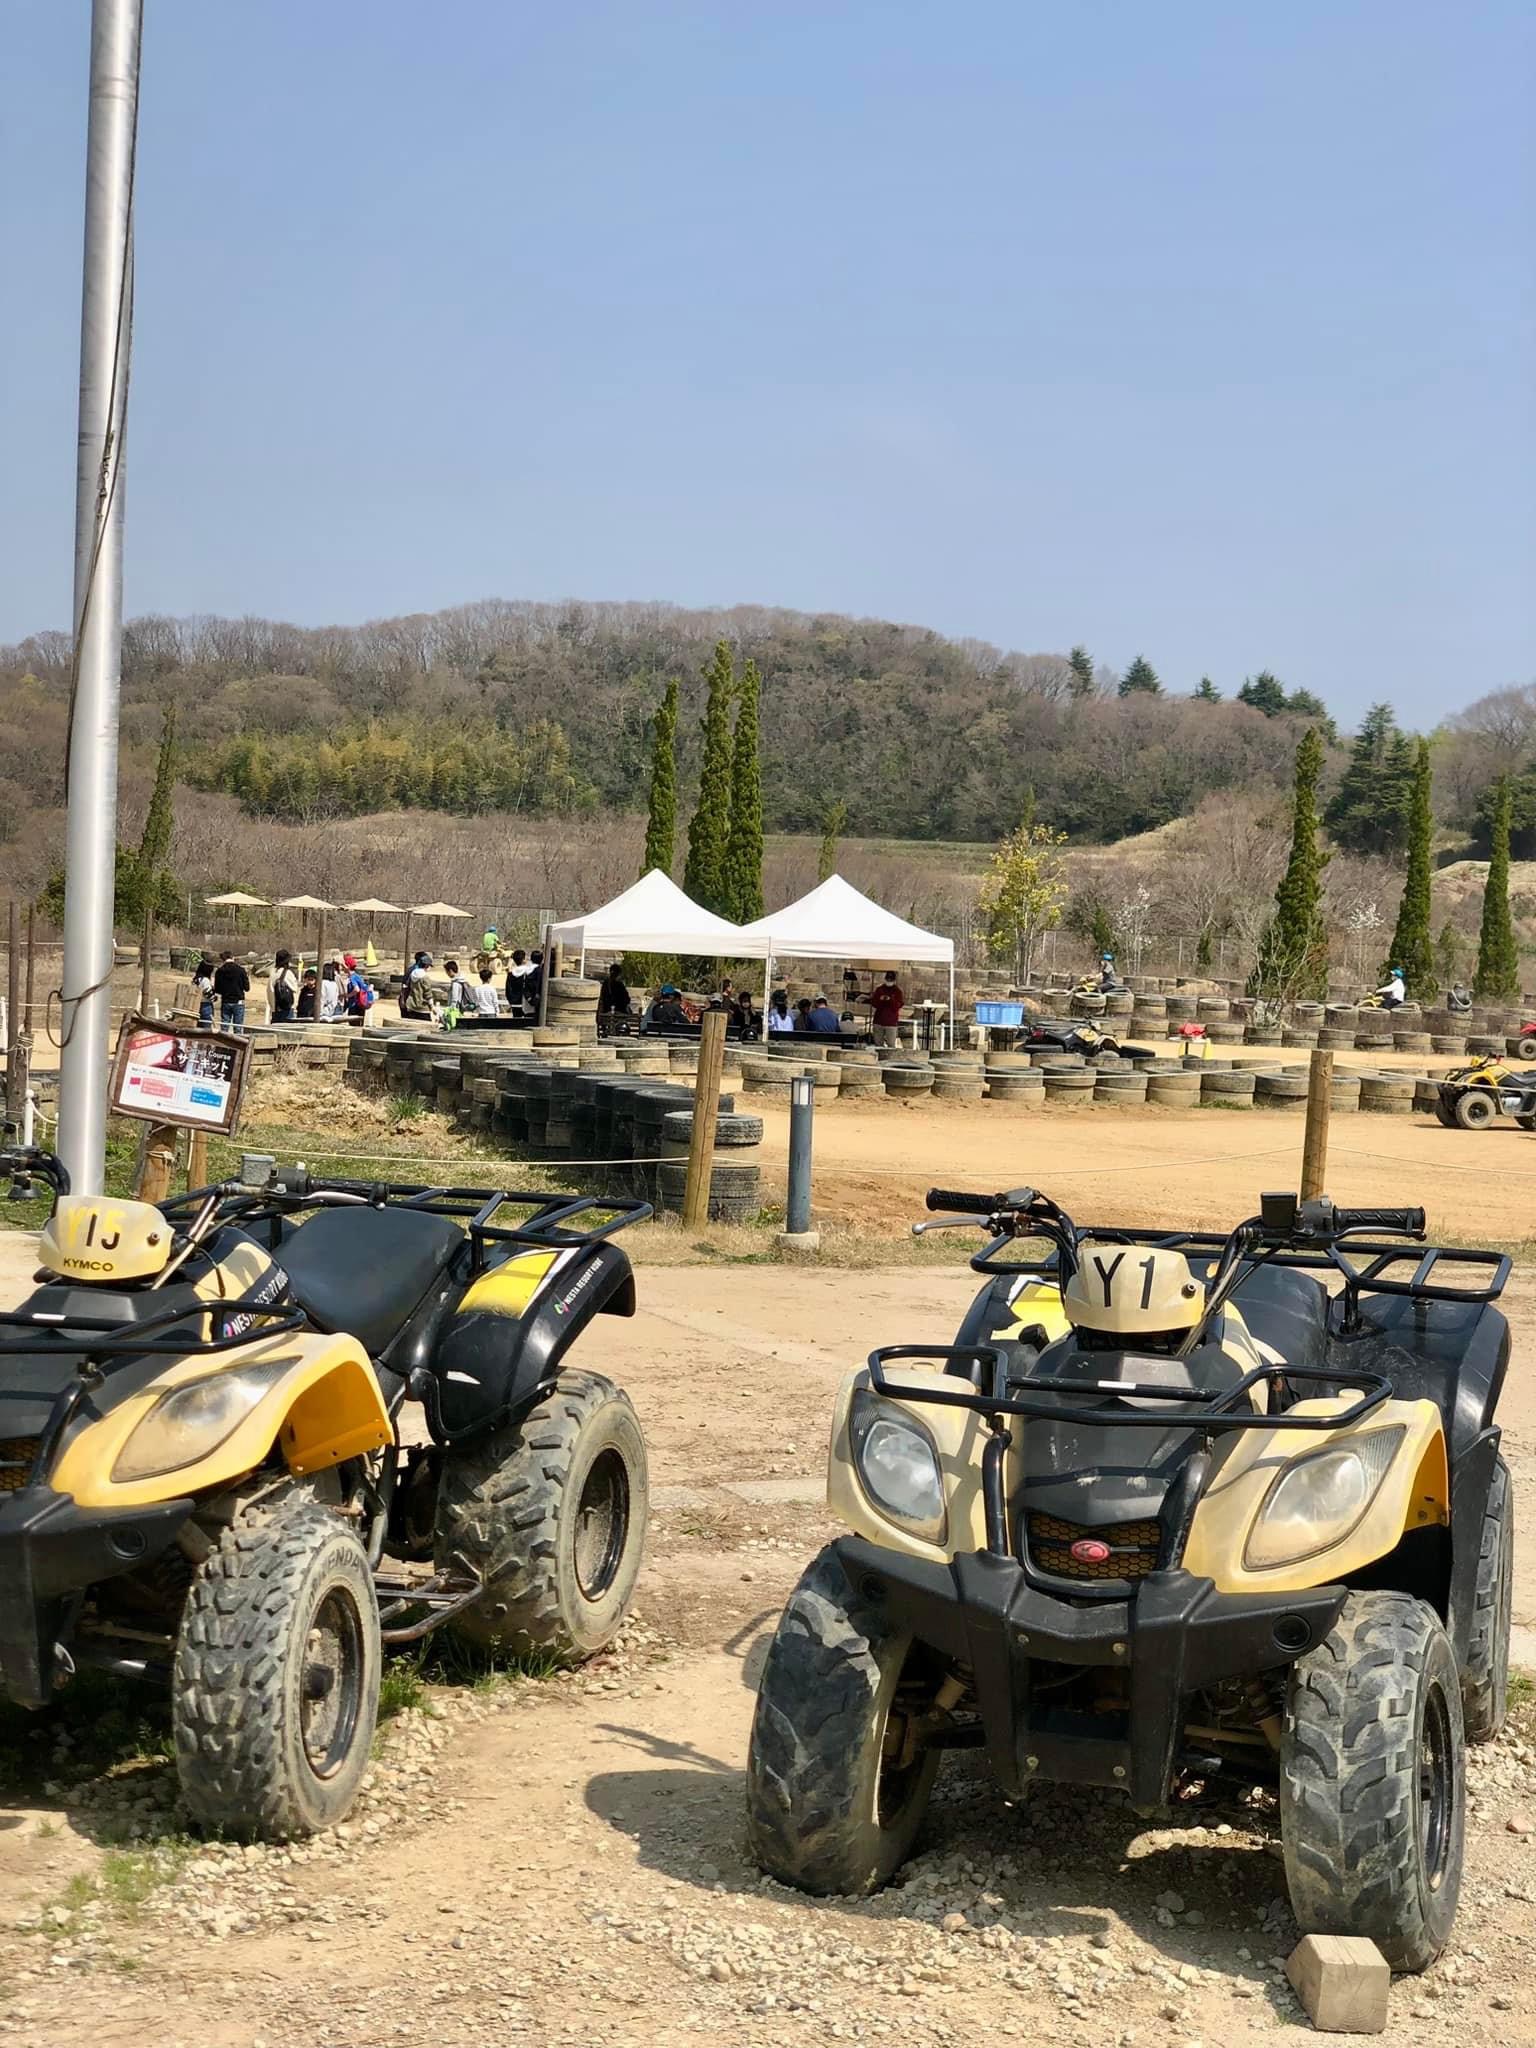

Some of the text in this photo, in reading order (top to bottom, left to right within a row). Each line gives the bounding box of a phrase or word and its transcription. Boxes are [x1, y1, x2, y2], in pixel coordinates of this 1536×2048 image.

[177, 1052, 229, 1073] サーキット
[194, 1069, 226, 1082] コース
[63, 1257, 114, 1273] KYMCO
